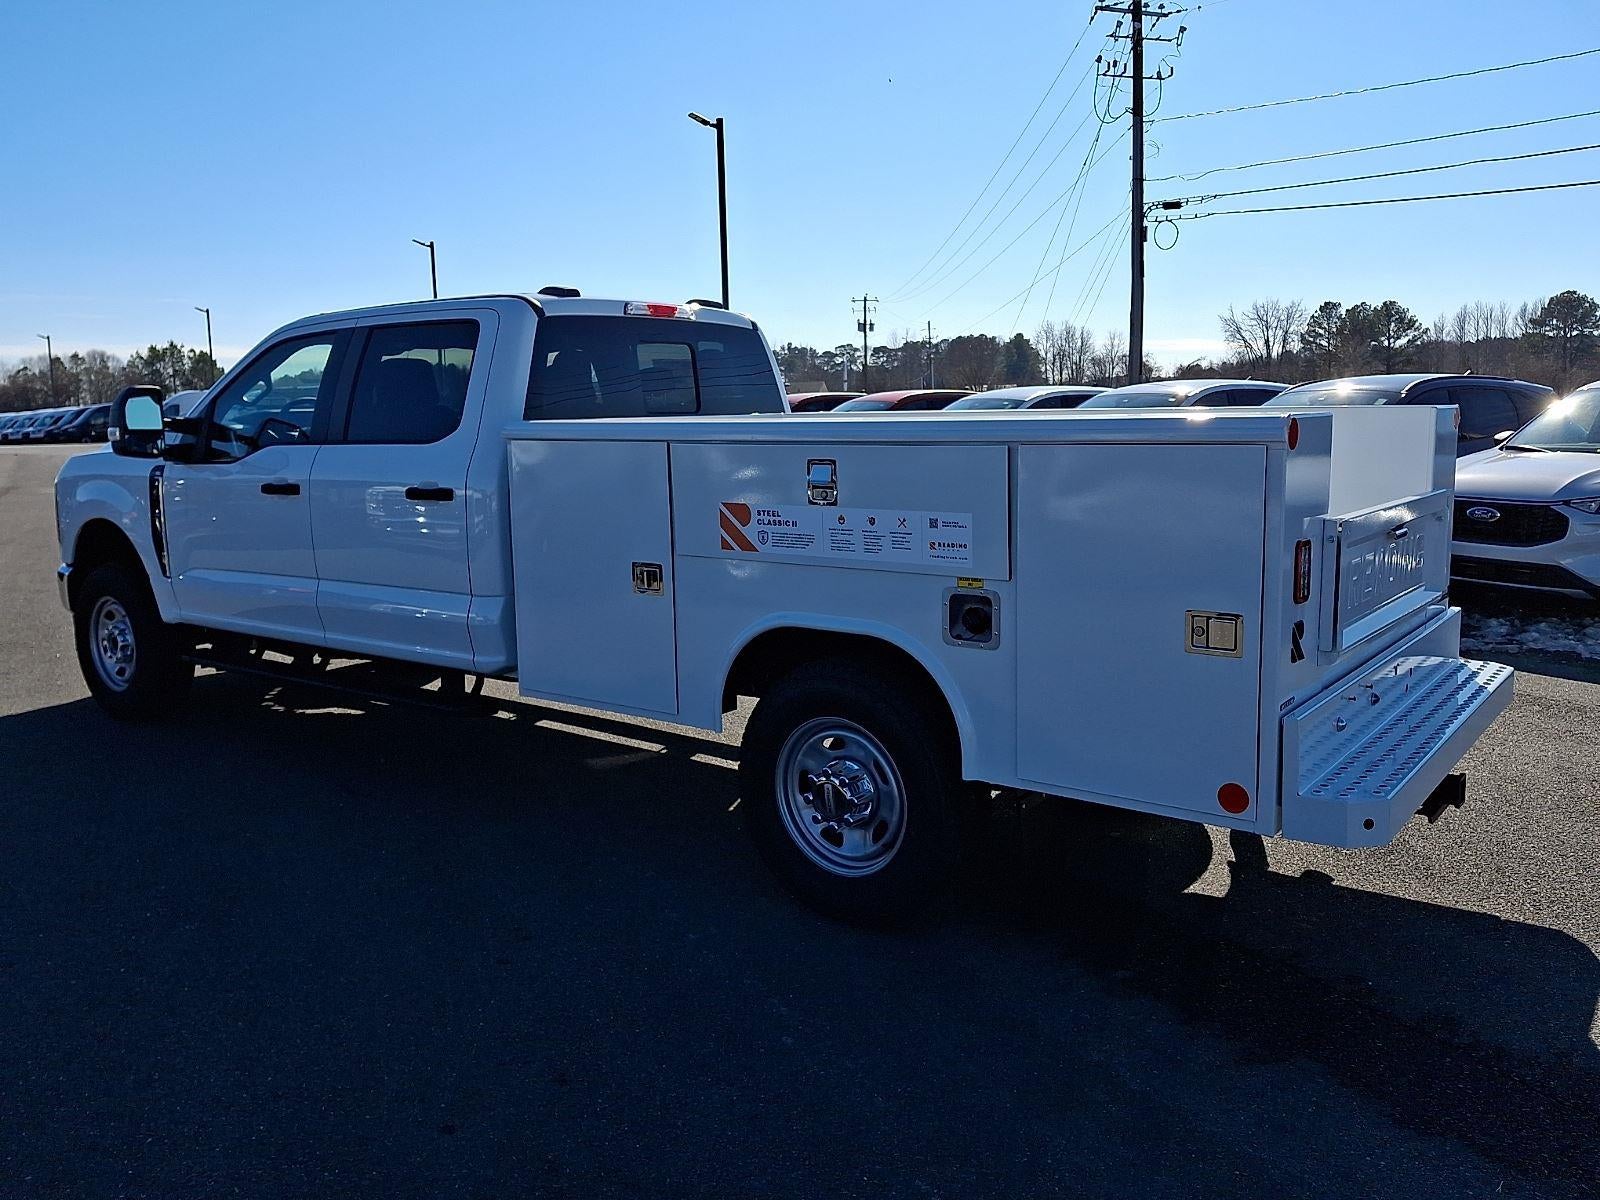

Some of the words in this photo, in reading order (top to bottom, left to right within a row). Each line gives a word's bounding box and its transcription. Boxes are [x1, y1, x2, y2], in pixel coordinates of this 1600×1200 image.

[756, 509, 782, 518] STEEL
[756, 518, 791, 528] CLASSIC
[792, 520, 798, 528] II
[938, 541, 968, 550] READING
